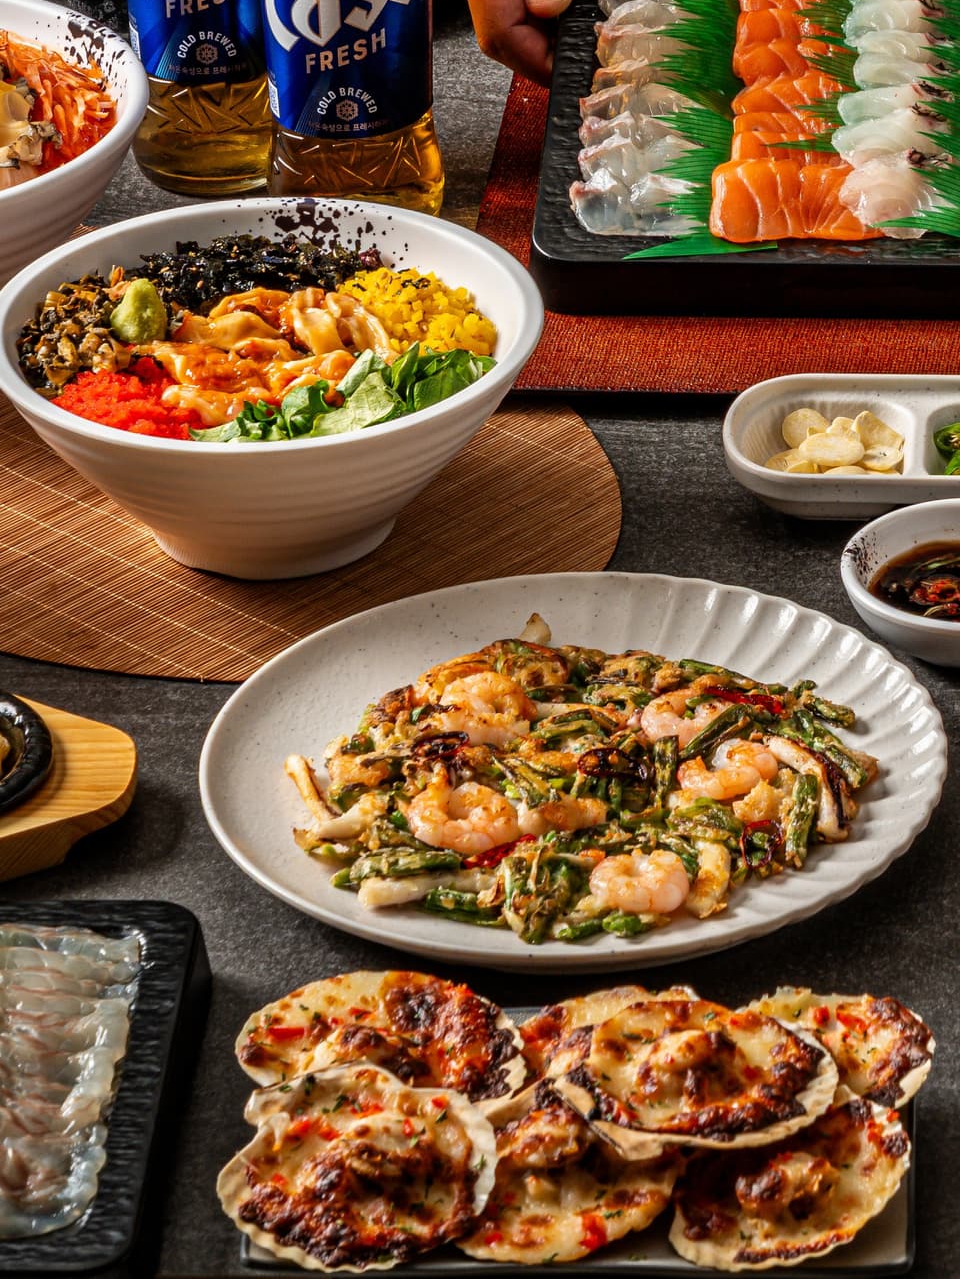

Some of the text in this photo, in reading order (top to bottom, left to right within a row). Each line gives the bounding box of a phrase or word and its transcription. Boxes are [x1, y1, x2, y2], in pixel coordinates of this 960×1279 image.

[177, 31, 237, 58] COLD BREWED
[305, 27, 387, 74] FRESH
[316, 87, 378, 115] COLD BREWED
